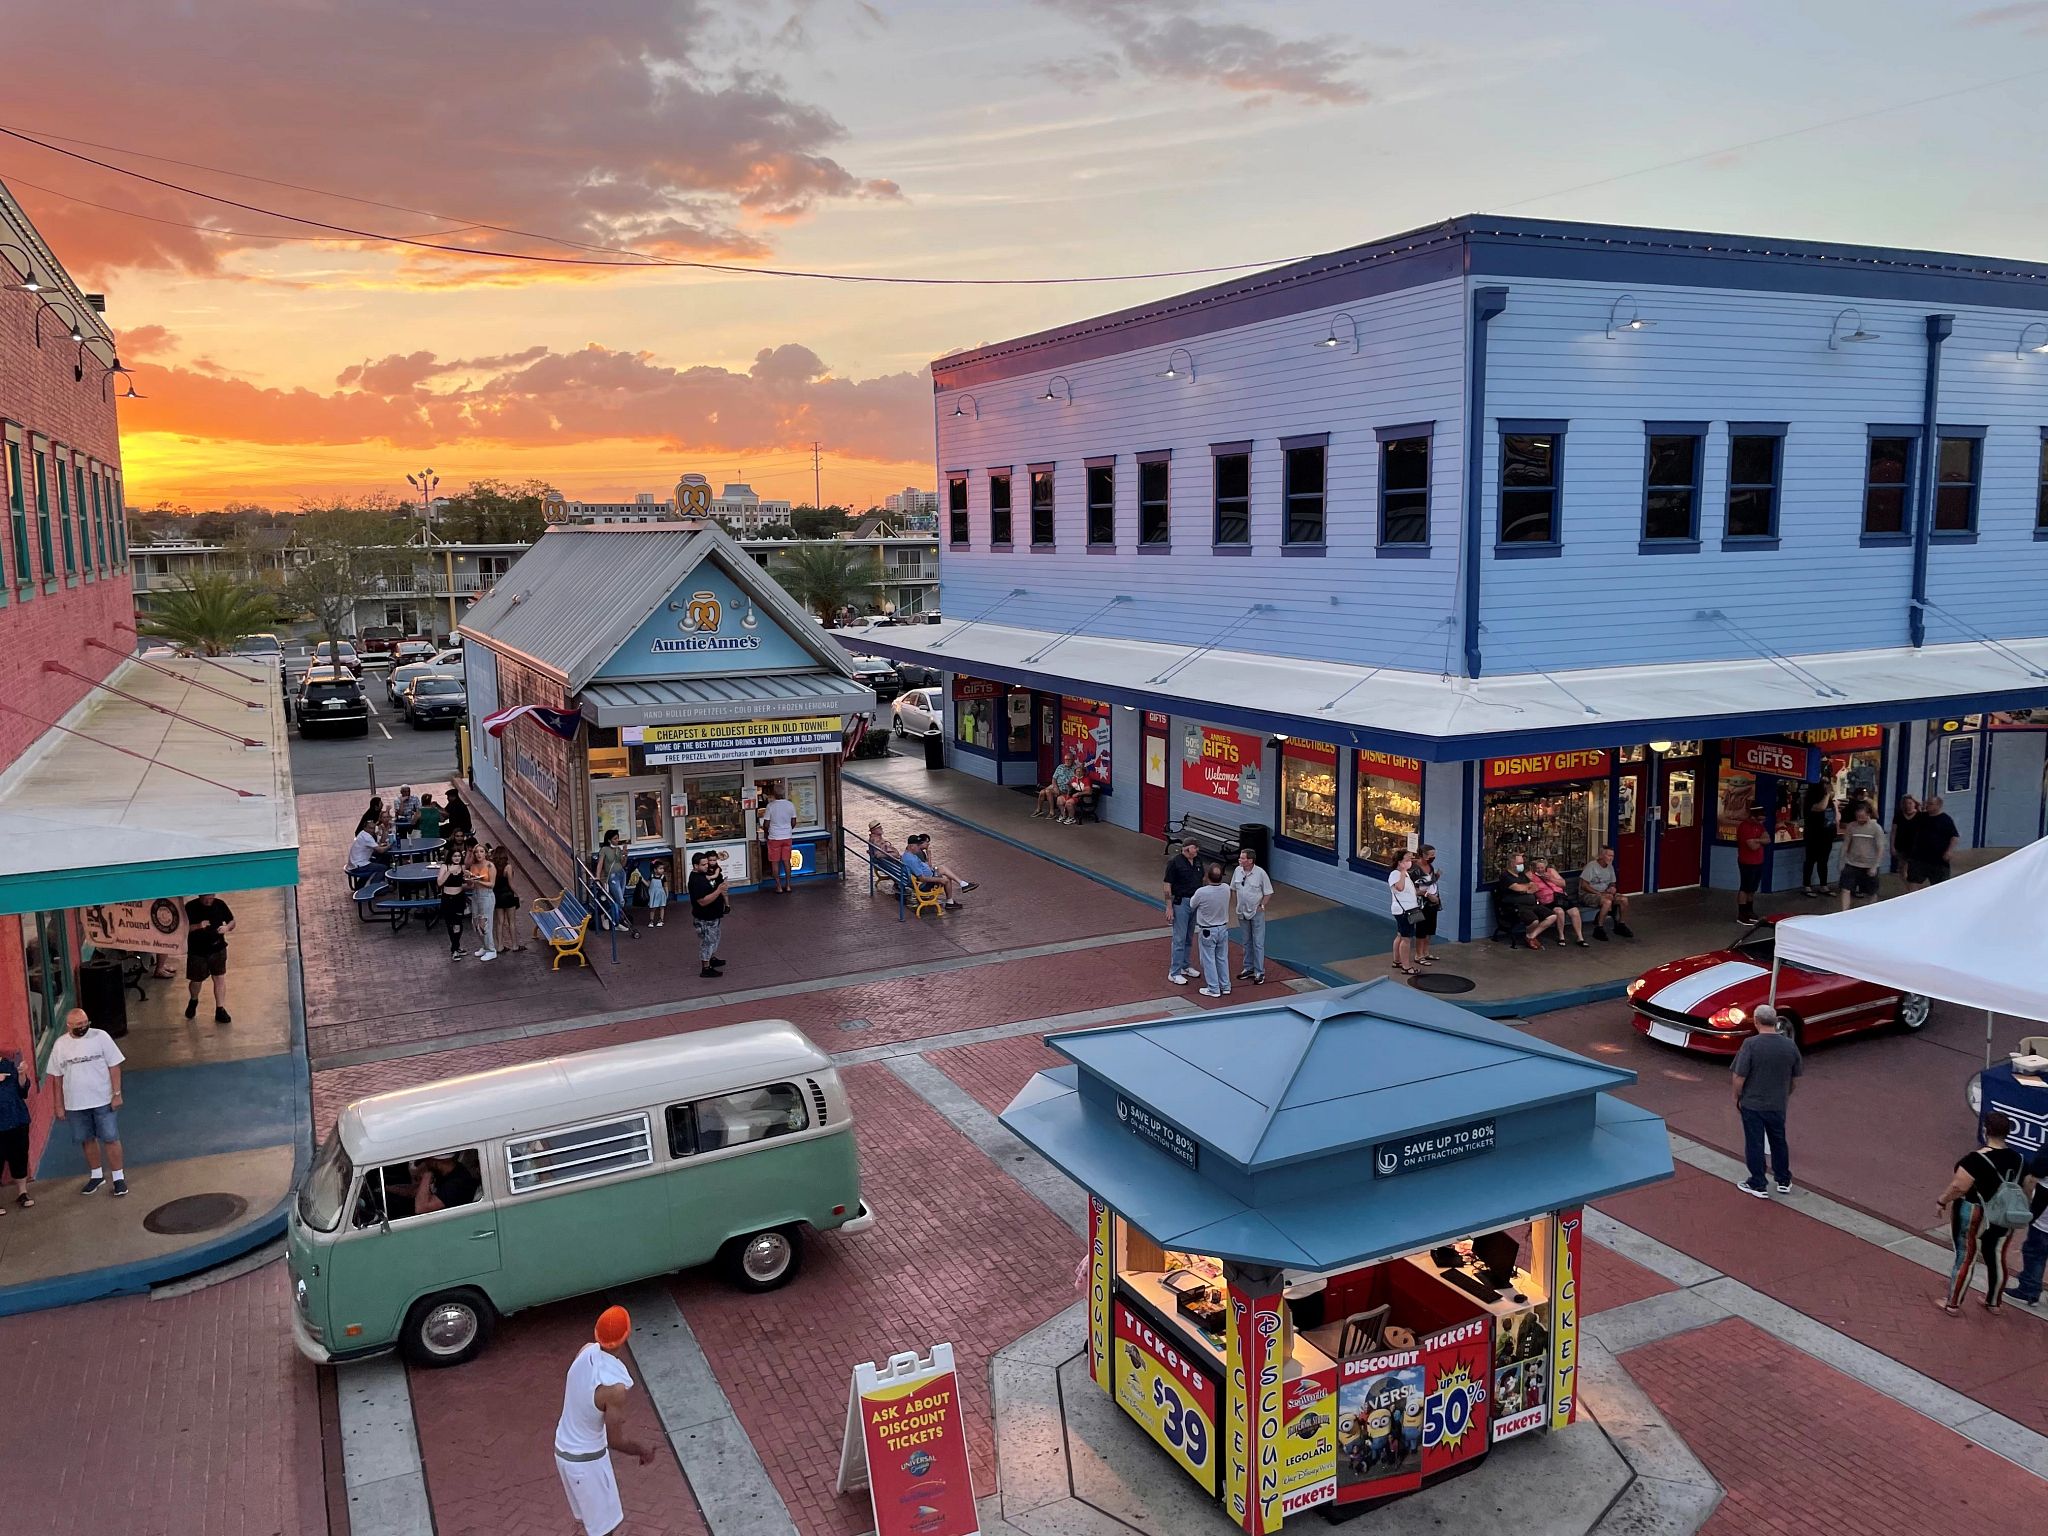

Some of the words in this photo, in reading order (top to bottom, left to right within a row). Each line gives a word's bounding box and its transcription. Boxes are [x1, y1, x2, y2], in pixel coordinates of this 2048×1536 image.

[963, 684, 993, 694] GIFTS
[694, 707, 727, 717] PRETZELS
[754, 704, 771, 713] BEER
[1149, 712, 1167, 723] GIFTS
[656, 728, 698, 740] CHEAPEST
[701, 727, 708, 737] &
[710, 725, 746, 737] COLDEST
[748, 724, 769, 735] BEER
[771, 723, 780, 733] IN
[782, 722, 798, 733] OLD
[800, 720, 828, 732] TOWN!!
[1062, 719, 1089, 739] GIFTS
[1840, 724, 1878, 740] GIFTS
[654, 743, 672, 752] HOME
[673, 742, 681, 751] OF
[683, 742, 694, 750] THE
[695, 741, 710, 750] BEST
[711, 739, 734, 749] FROZEN
[735, 738, 756, 747] DRINKS
[763, 736, 793, 745] DAIQUIRIS
[794, 735, 800, 743] IN
[801, 734, 813, 742] OLD
[1187, 747, 1197, 755] OFF
[1202, 739, 1239, 763] GIFTS
[665, 754, 680, 762] FREE
[681, 753, 706, 761] PRETZEL
[708, 752, 721, 760] with
[721, 750, 748, 760] purchase
[749, 749, 756, 757] of
[757, 749, 767, 758] any
[773, 747, 790, 755] beers
[1361, 749, 1391, 765] DISNEY
[1392, 755, 1419, 771] GIFTS
[1494, 755, 1552, 776] DISNEY
[1554, 750, 1600, 770] GIFTS
[1747, 749, 1793, 769] GIFTS
[1204, 766, 1240, 782] Welcomes
[1212, 781, 1230, 796] You!
[118, 918, 150, 930] Around
[1130, 1105, 1149, 1126] SAVE
[1150, 1118, 1161, 1132] UP
[1162, 1125, 1174, 1140] TO
[1175, 1134, 1194, 1153] 80%
[1130, 1117, 1138, 1127] ON
[1139, 1123, 1170, 1148] ATTRACTION
[1170, 1143, 1193, 1163] TICKETS
[1404, 1140, 1434, 1156] SAVE
[1436, 1136, 1452, 1149] UP
[1454, 1131, 1469, 1144] TO
[1471, 1124, 1494, 1140] 80%
[1403, 1158, 1416, 1166] ON
[1417, 1145, 1464, 1164] ATTRACTION
[1465, 1137, 1494, 1152] TICKETS
[1558, 1218, 1579, 1415] TICKETS
[1440, 1378, 1453, 1390] UP
[1455, 1372, 1467, 1384] TO
[872, 1405, 900, 1424] ASK
[905, 1392, 950, 1415] ABOUT
[1231, 1296, 1247, 1515] TICKETS
[1422, 1379, 1486, 1447] 50%
[879, 1409, 946, 1438] DISCOUNT
[1154, 1376, 1208, 1466] $39
[887, 1426, 943, 1451] TICKETS
[1286, 1444, 1333, 1467] LEGOLAND
